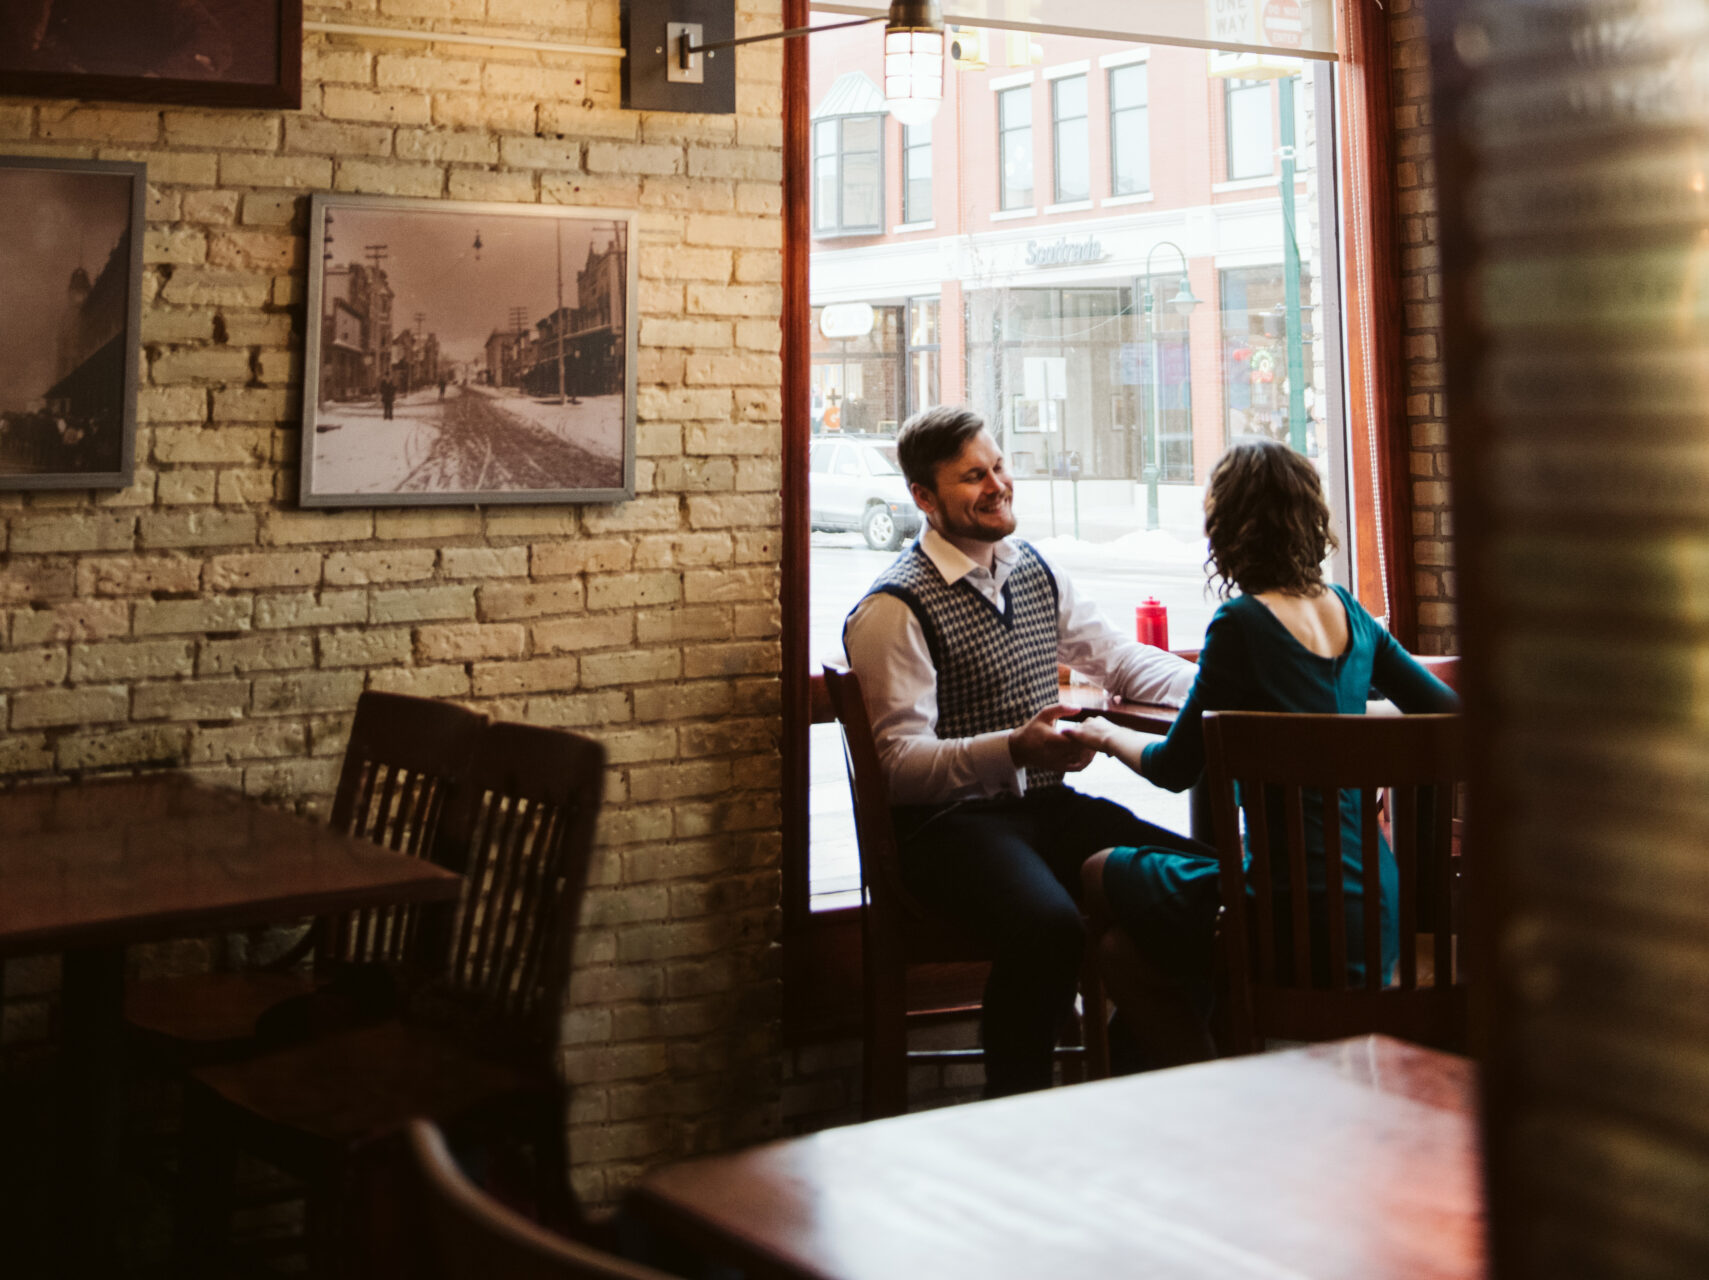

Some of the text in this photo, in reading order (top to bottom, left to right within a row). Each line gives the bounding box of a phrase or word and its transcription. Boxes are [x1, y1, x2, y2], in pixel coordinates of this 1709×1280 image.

[1267, 4, 1280, 16] DO
[1216, 14, 1247, 35] WAY
[1272, 32, 1298, 42] ENTER
